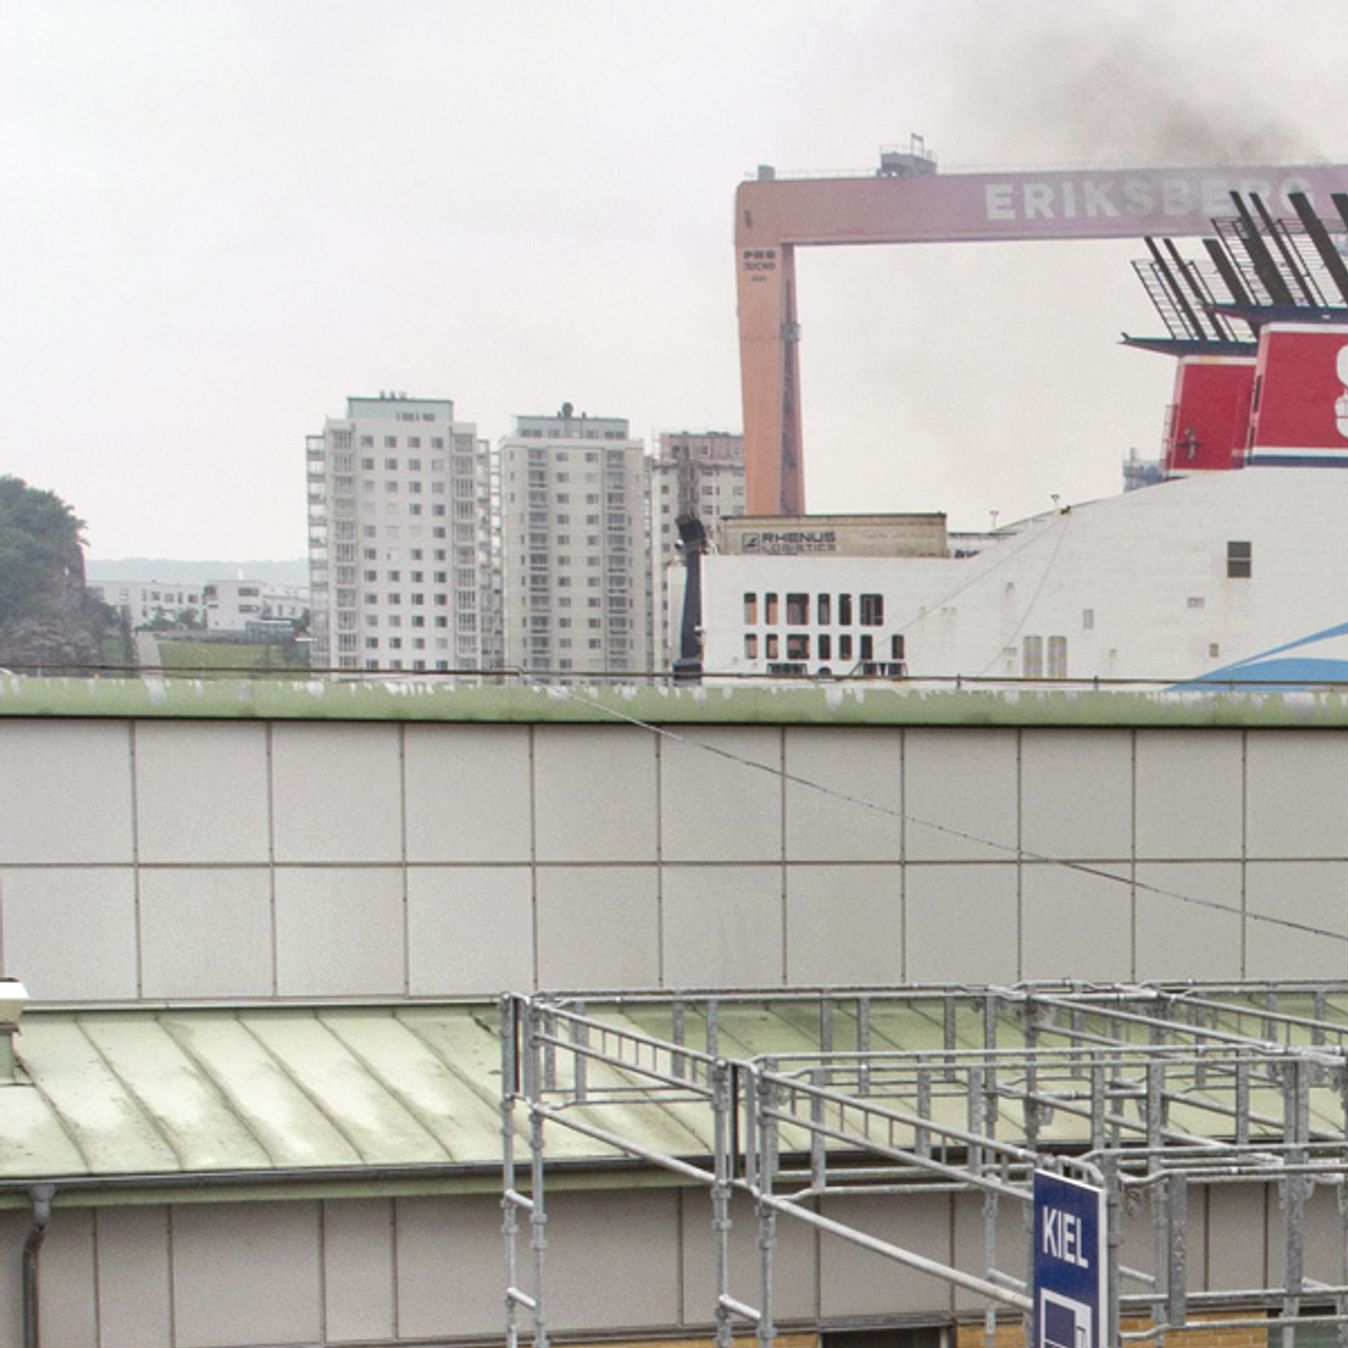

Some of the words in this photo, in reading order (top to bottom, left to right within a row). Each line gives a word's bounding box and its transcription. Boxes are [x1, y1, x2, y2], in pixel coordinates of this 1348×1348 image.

[984, 177, 1315, 220] ERIKSBERG
[762, 531, 836, 543] RHENUS
[1042, 1206, 1089, 1269] KIEL
